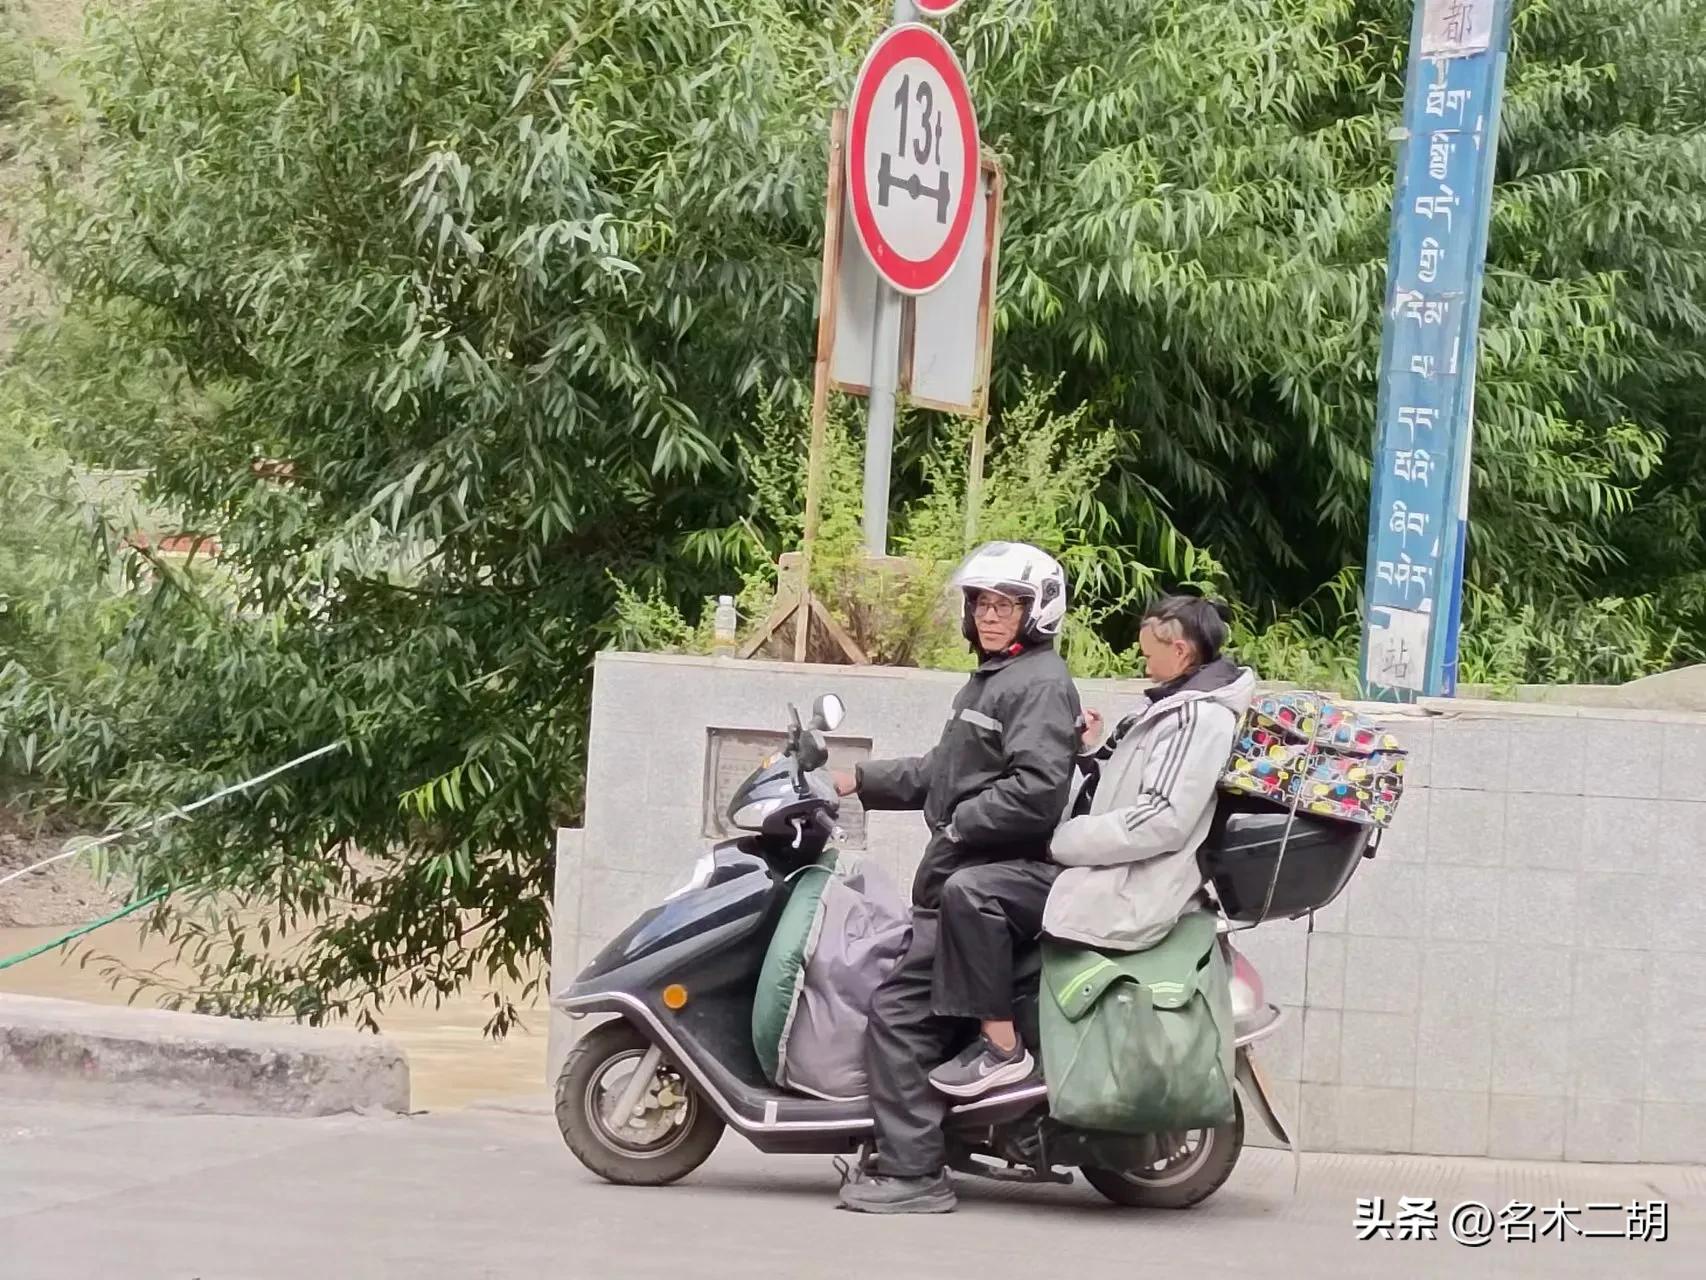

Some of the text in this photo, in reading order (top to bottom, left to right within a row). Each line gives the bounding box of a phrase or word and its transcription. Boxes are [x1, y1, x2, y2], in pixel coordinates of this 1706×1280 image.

[1442, 0, 1473, 43] 都
[894, 73, 943, 166] 13t
[1383, 637, 1407, 678] 站
